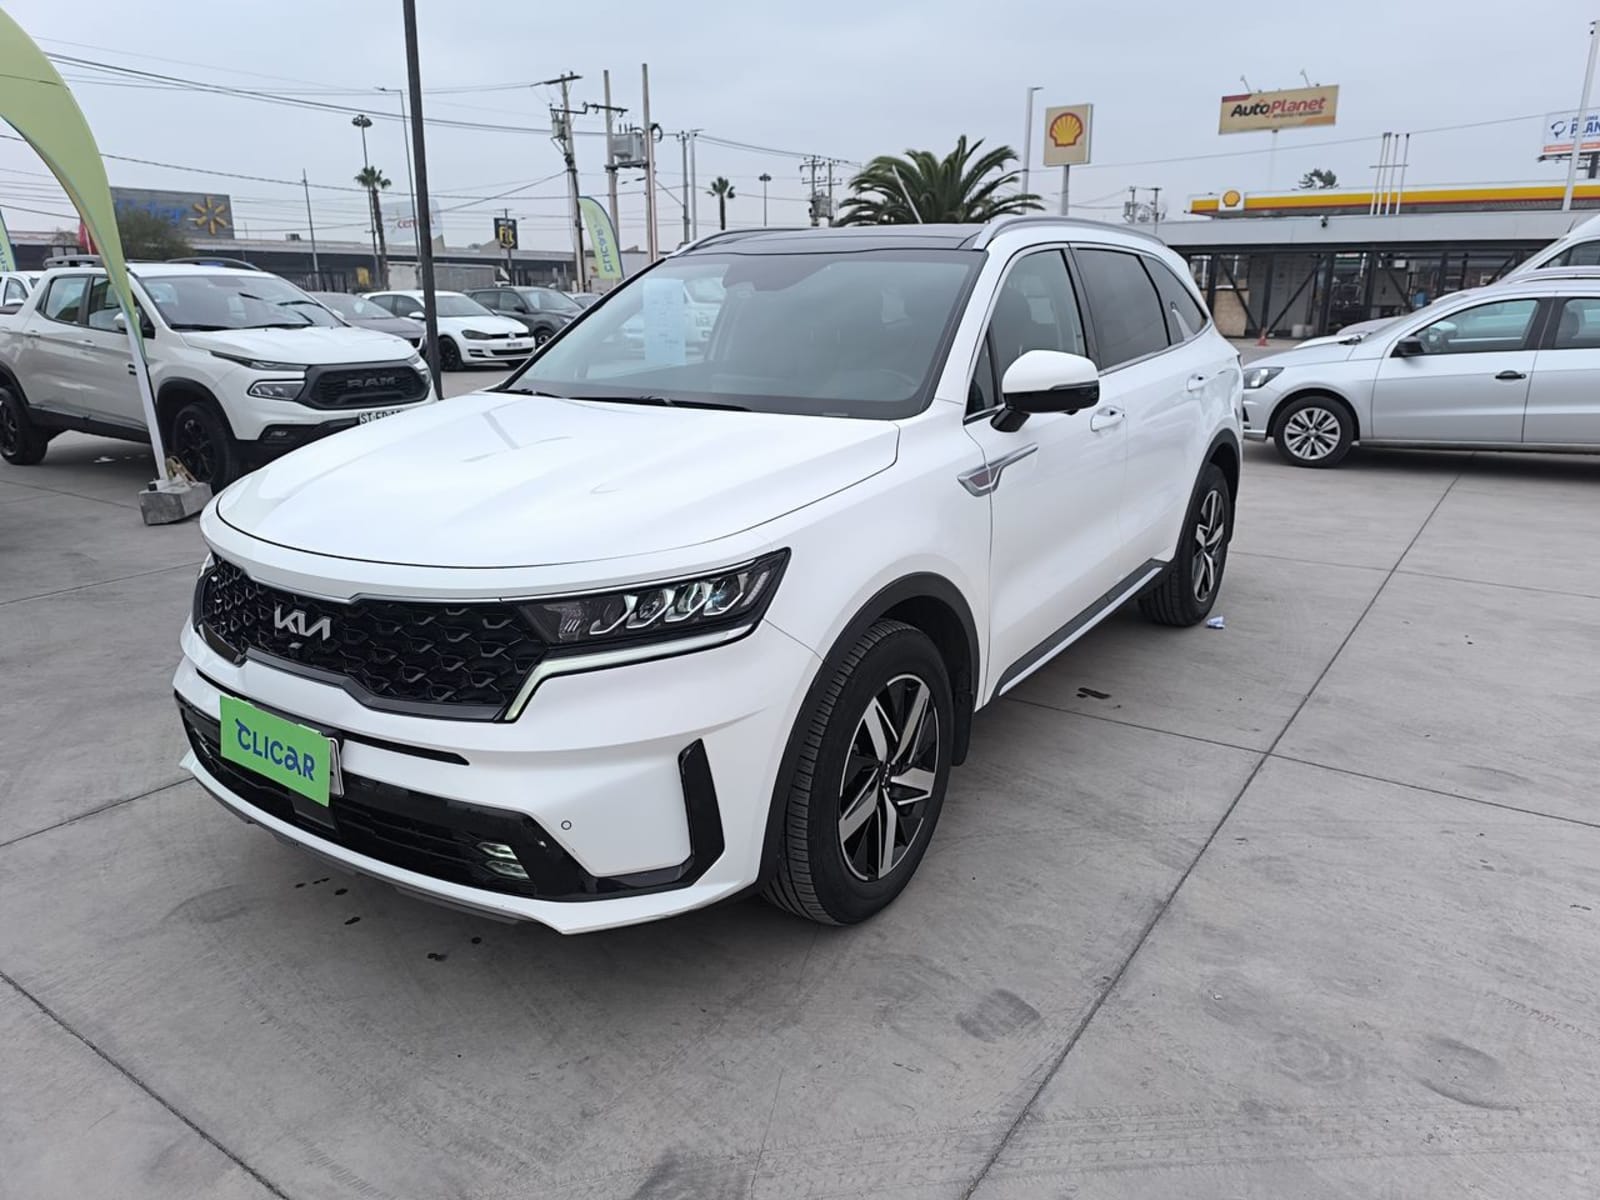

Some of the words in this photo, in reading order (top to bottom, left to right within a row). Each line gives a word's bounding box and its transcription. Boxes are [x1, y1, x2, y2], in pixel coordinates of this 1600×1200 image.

[1231, 98, 1326, 118] AutoPlanet
[347, 377, 396, 388] RAM
[274, 605, 332, 641] KIA
